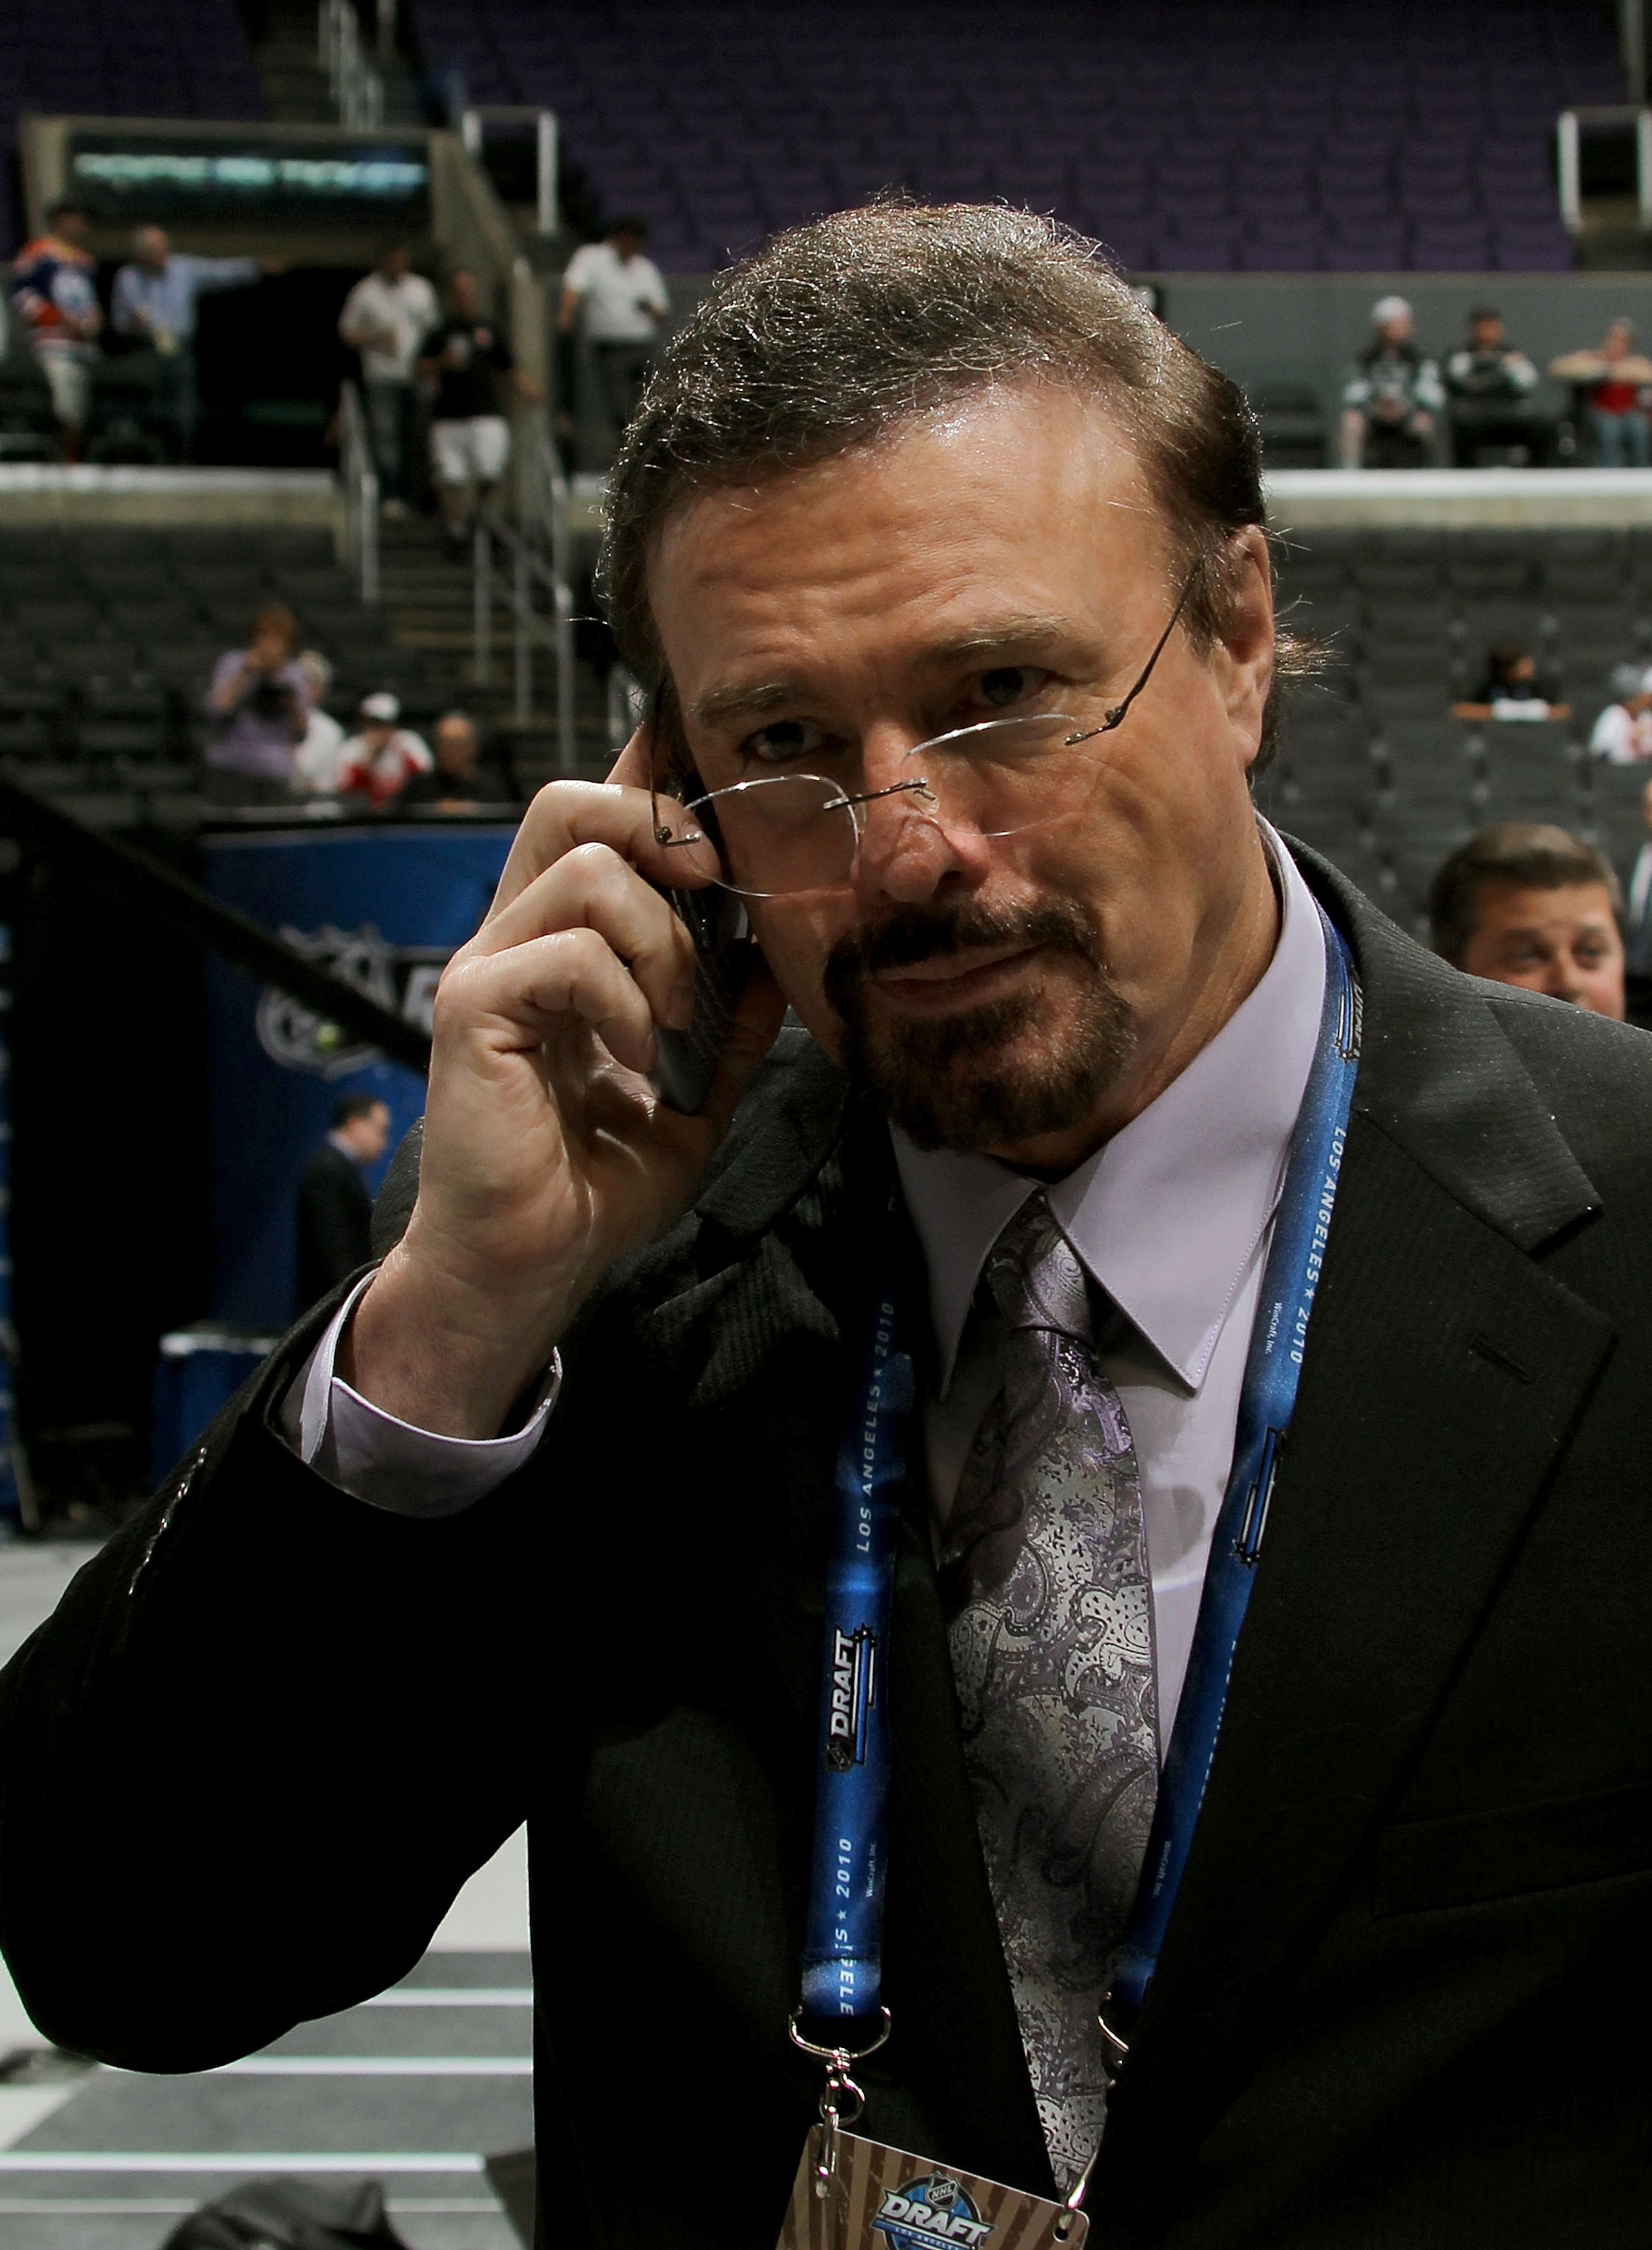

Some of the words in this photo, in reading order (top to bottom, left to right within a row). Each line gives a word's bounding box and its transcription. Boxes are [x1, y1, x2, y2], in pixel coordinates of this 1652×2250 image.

[1328, 1126, 1347, 1171] LOS
[1306, 1175, 1336, 1284] ANGELES
[875, 1302, 894, 1357] 2010
[861, 1384, 881, 1497] ANGELES
[856, 1506, 872, 1553] LOS
[831, 1628, 854, 1738] DRAFT
[836, 1838, 852, 1899] 2010
[881, 2193, 991, 2244] DRAFT
[931, 2183, 953, 2200] NHL
